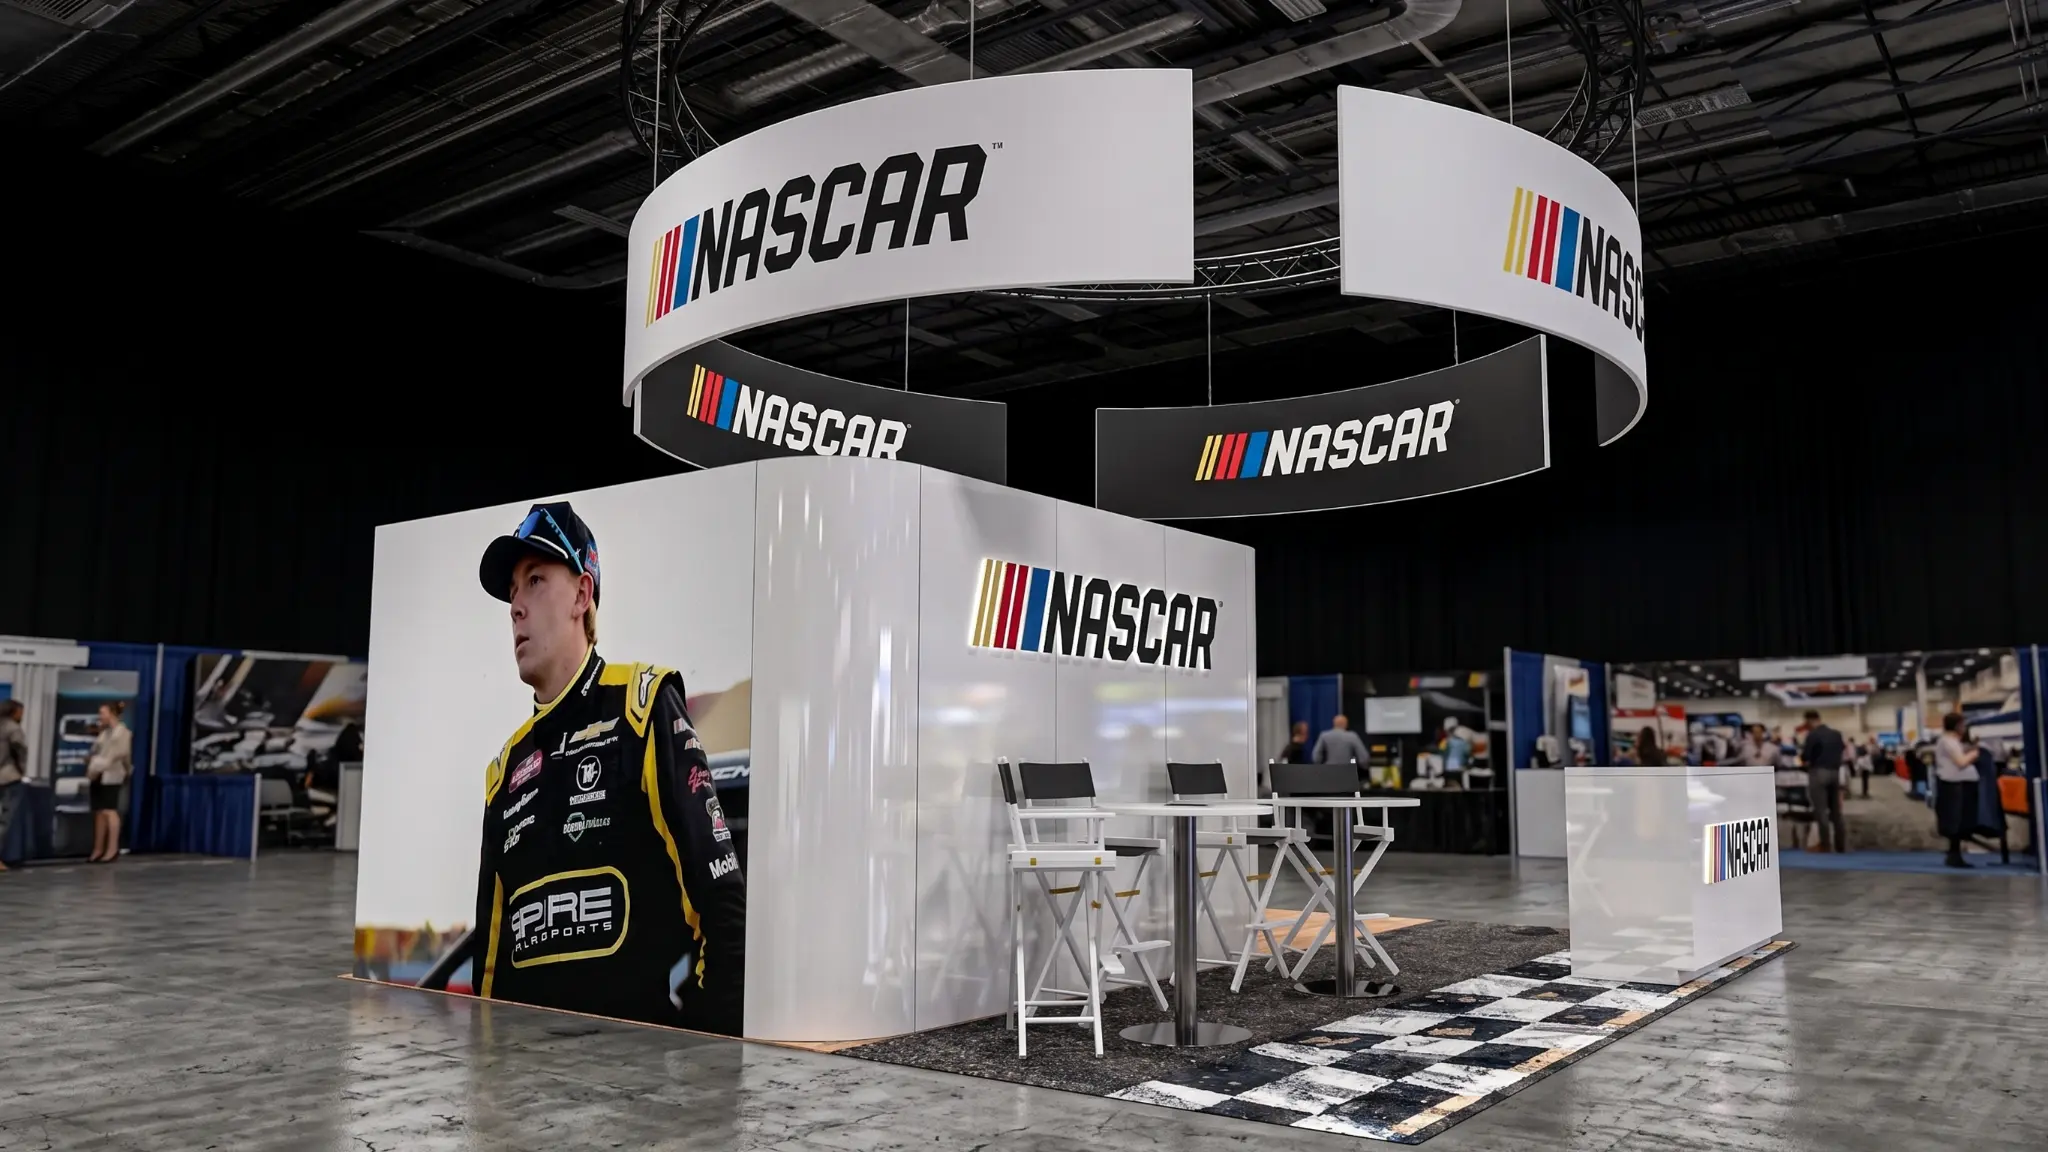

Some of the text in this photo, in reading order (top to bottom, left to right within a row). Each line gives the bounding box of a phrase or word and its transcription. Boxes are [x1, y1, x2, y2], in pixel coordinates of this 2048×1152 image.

[691, 144, 987, 301] NASCAR
[732, 384, 907, 460] NASCAR
[1262, 400, 1454, 477] NASCAR
[1043, 571, 1218, 670] NASCAR
[1726, 817, 1770, 879] NASCAR
